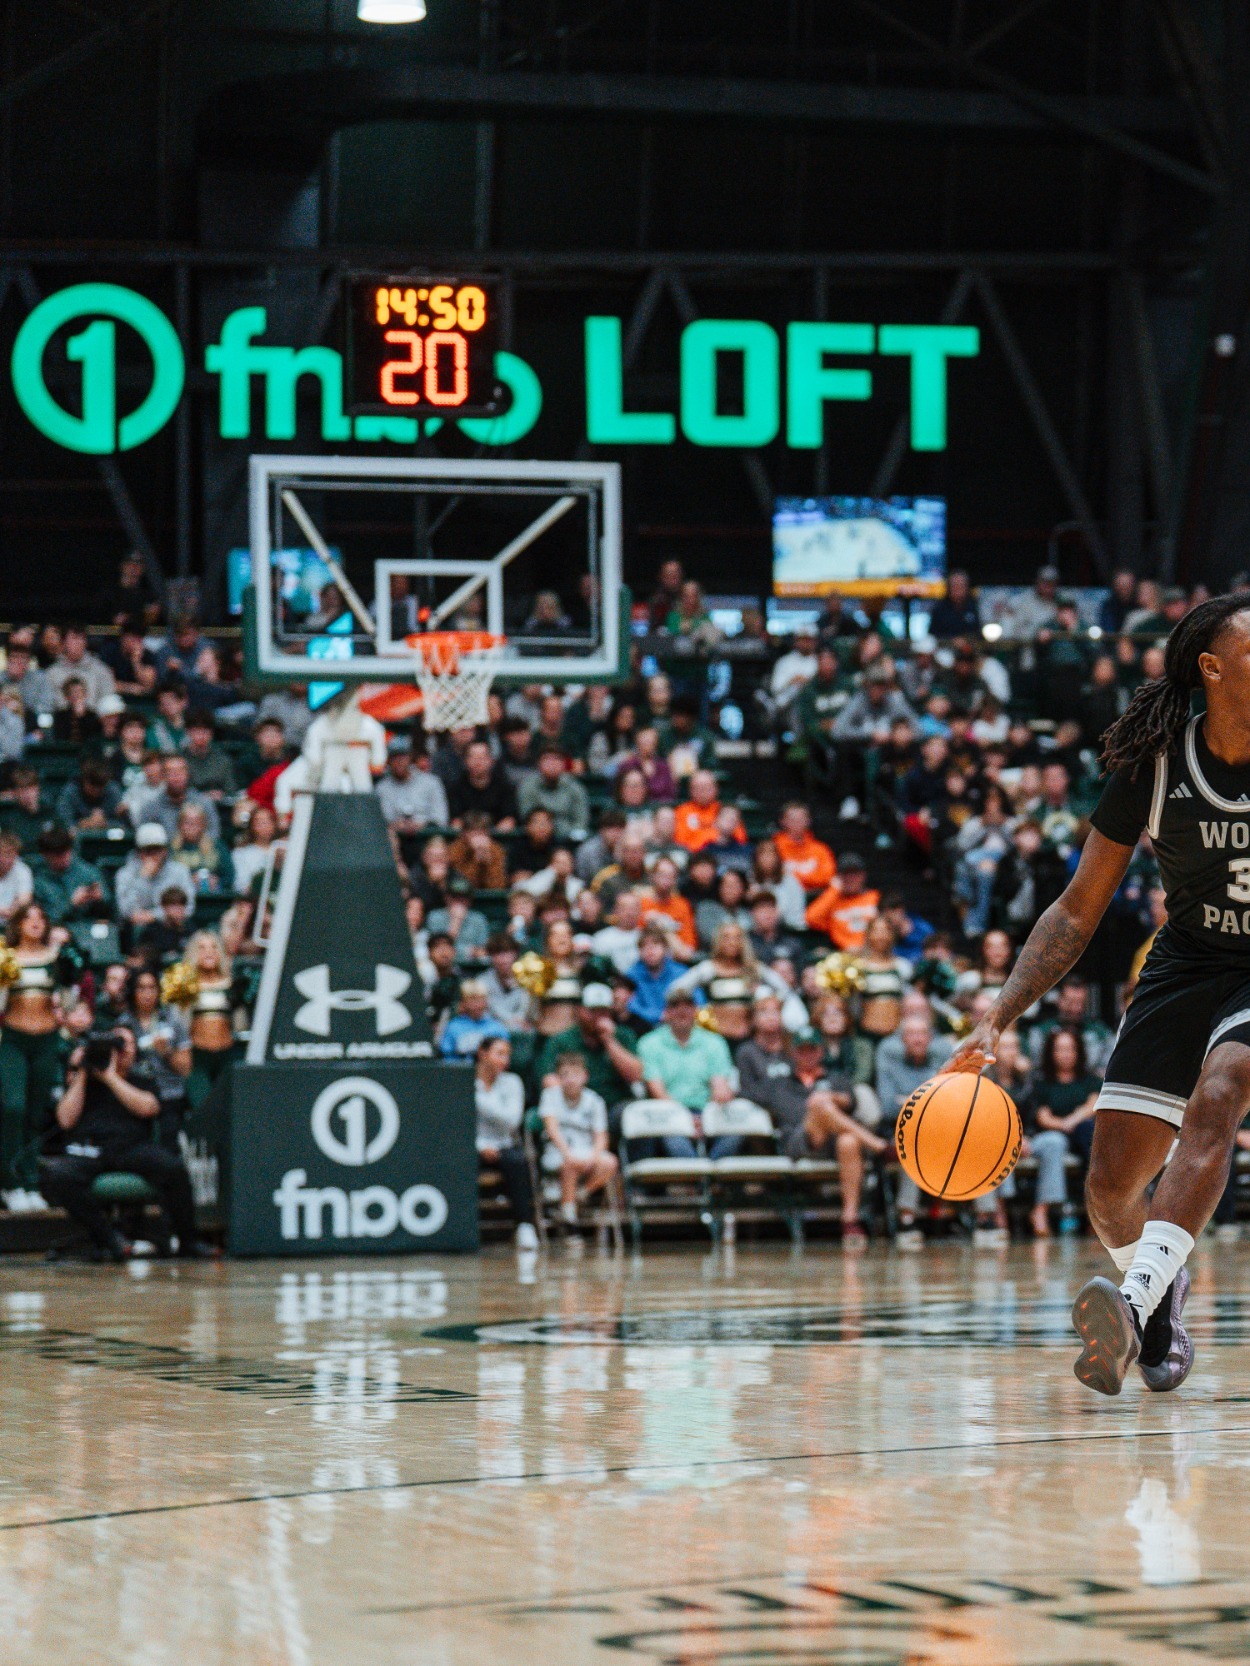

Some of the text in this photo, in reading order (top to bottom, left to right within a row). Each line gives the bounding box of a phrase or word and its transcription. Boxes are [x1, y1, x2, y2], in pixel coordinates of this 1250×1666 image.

[376, 285, 486, 331] 14:50
[381, 331, 468, 405] 20
[585, 316, 980, 452] LOFT
